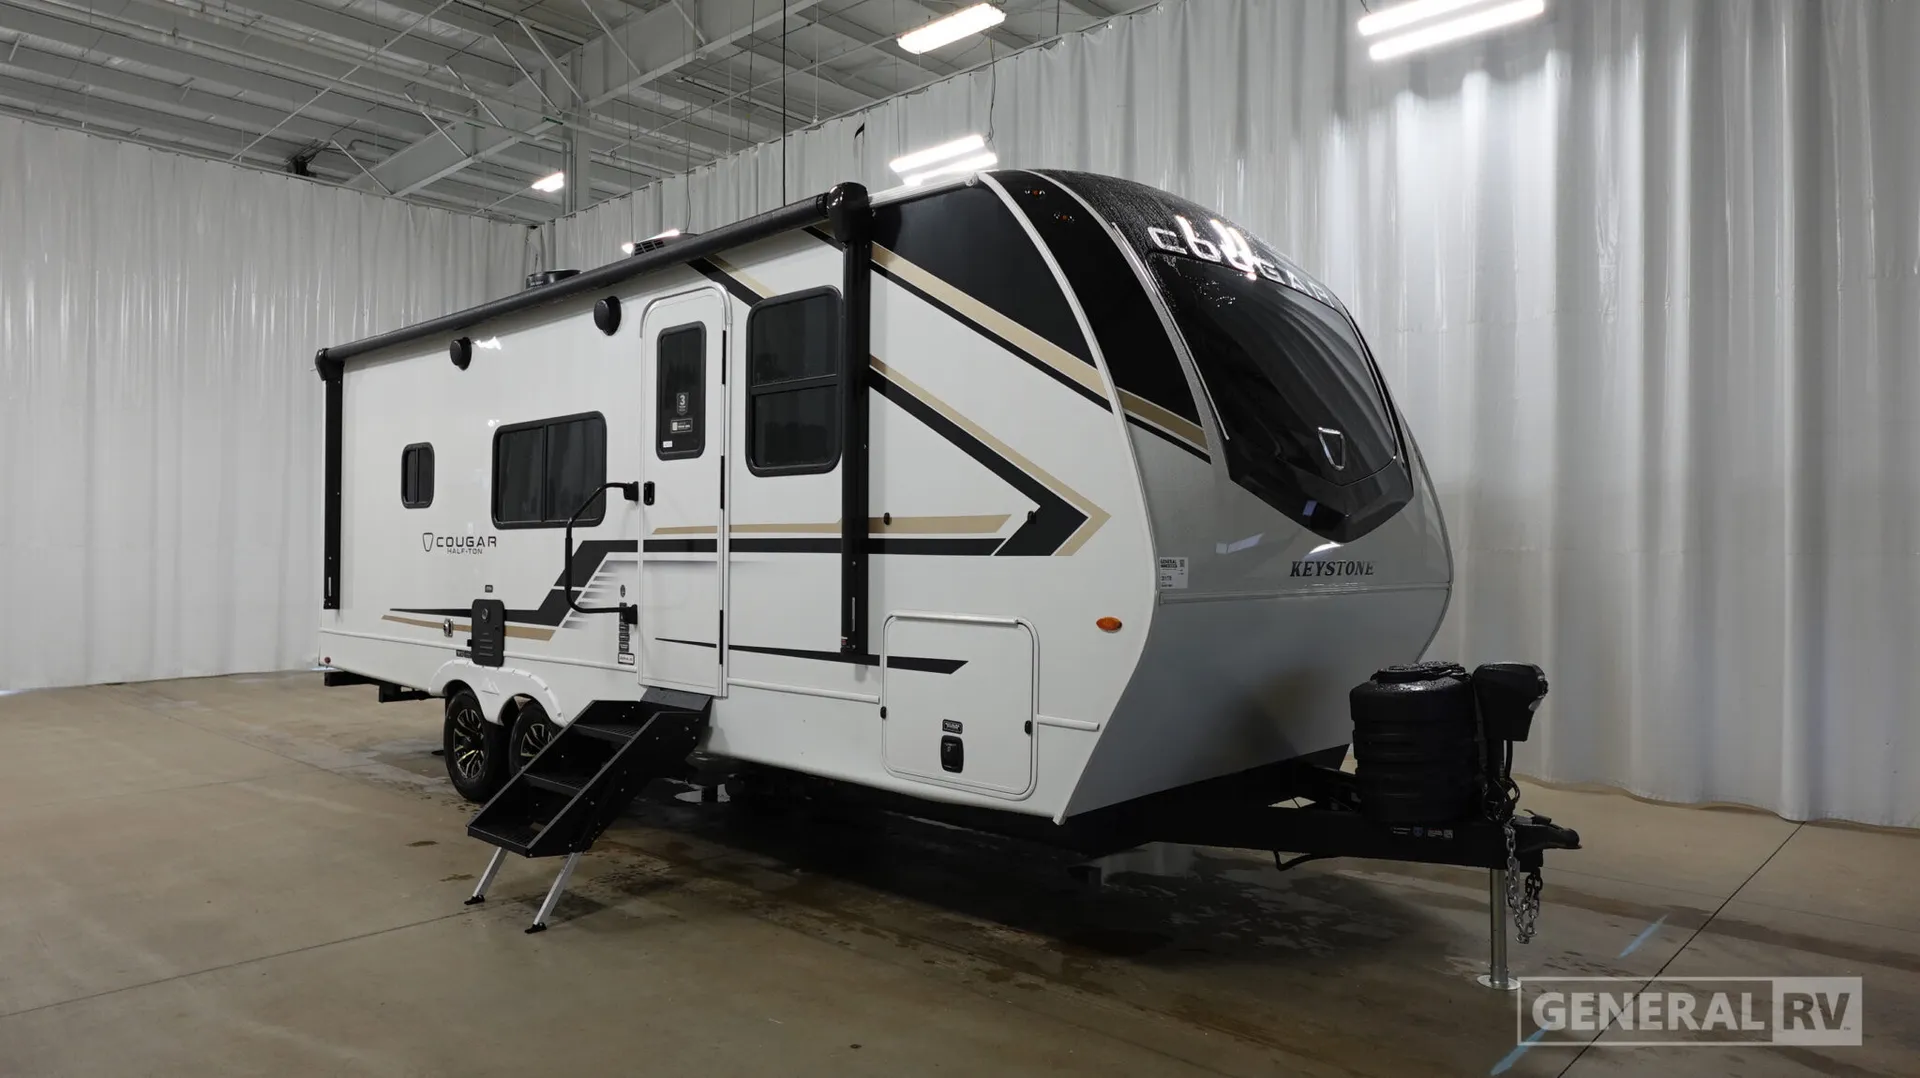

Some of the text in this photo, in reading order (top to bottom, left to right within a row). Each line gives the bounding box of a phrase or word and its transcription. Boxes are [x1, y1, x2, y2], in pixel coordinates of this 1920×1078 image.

[679, 394, 686, 405] 3
[436, 536, 497, 547] COUGAR
[1290, 561, 1374, 577] KEYSTONE
